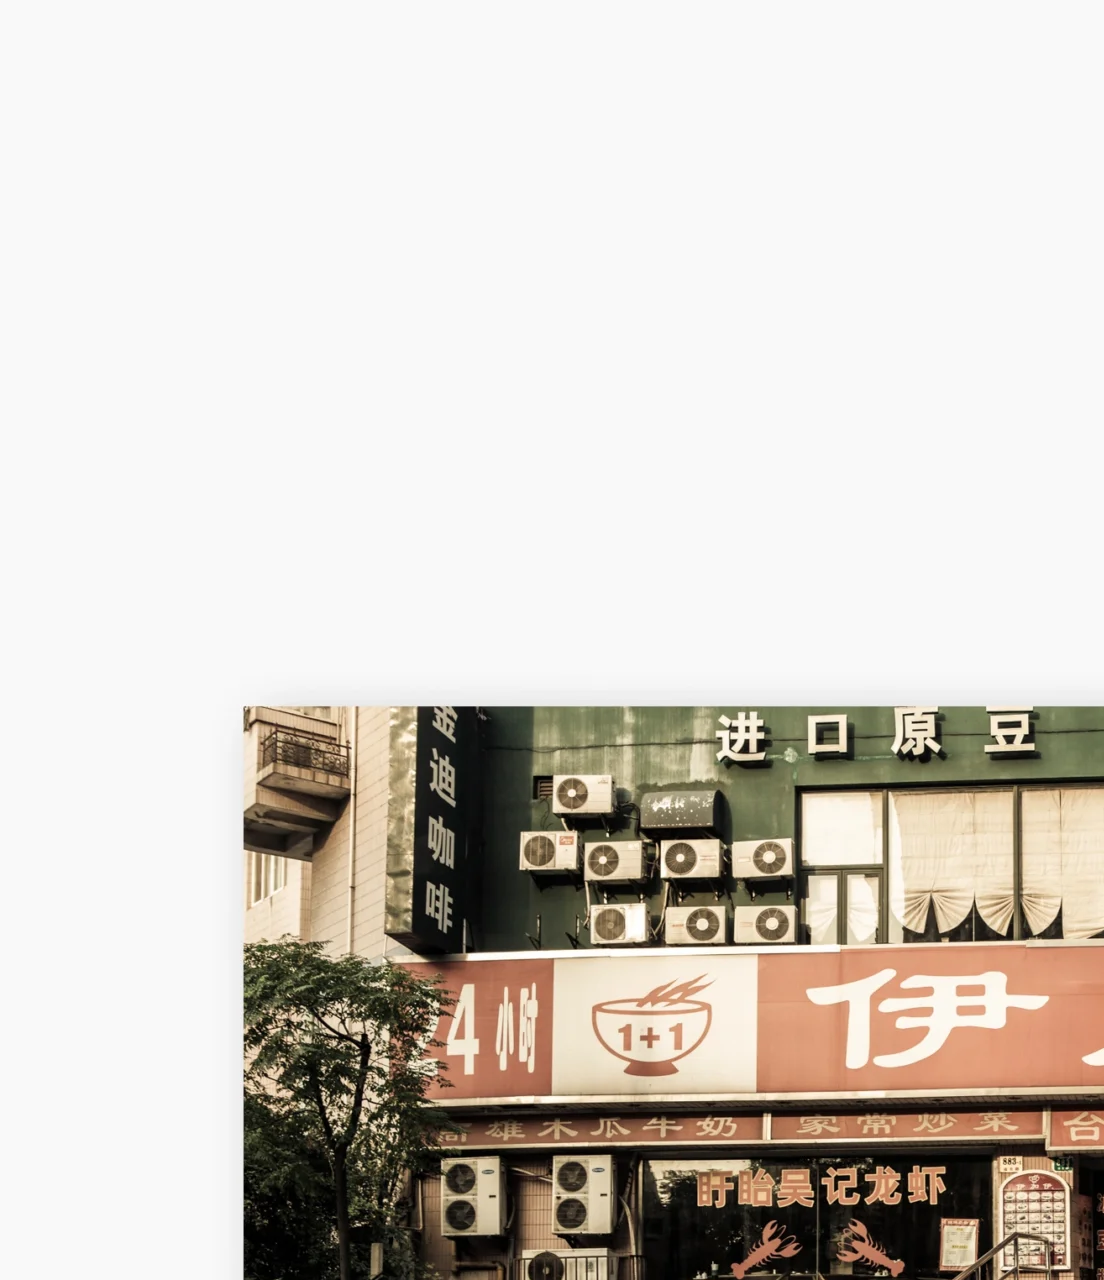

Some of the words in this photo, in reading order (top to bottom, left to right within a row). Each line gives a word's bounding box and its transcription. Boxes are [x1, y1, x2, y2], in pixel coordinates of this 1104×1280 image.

[715, 706, 1037, 763] 进口原豆
[425, 706, 459, 934] 金迪咖啡
[618, 1022, 683, 1051] 1+1
[796, 1111, 1019, 1135] 家常炒菜
[697, 1165, 946, 1208] 盱眙吴记龙虾
